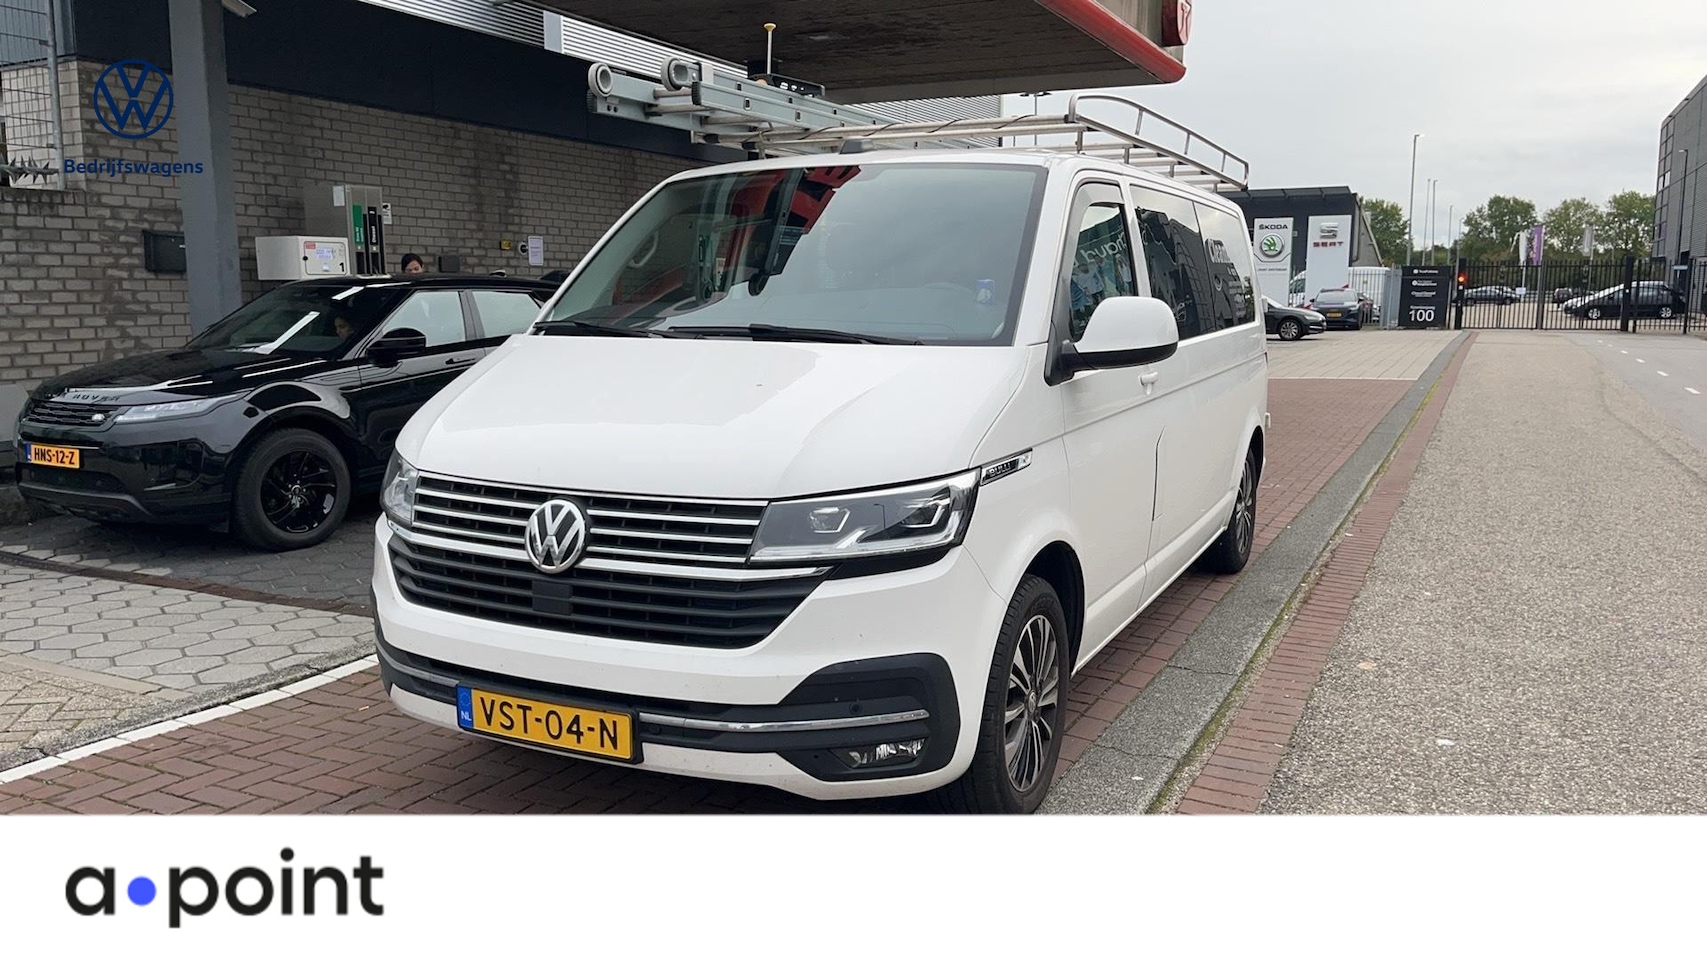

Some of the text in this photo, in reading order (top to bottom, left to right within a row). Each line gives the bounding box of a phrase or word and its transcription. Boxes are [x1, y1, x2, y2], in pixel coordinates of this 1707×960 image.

[1258, 223, 1288, 231] ŠKODA
[1409, 309, 1435, 322] 100
[34, 447, 75, 465] HNS-12-Z
[461, 711, 472, 721] NL
[480, 696, 618, 750] VST-04-N
